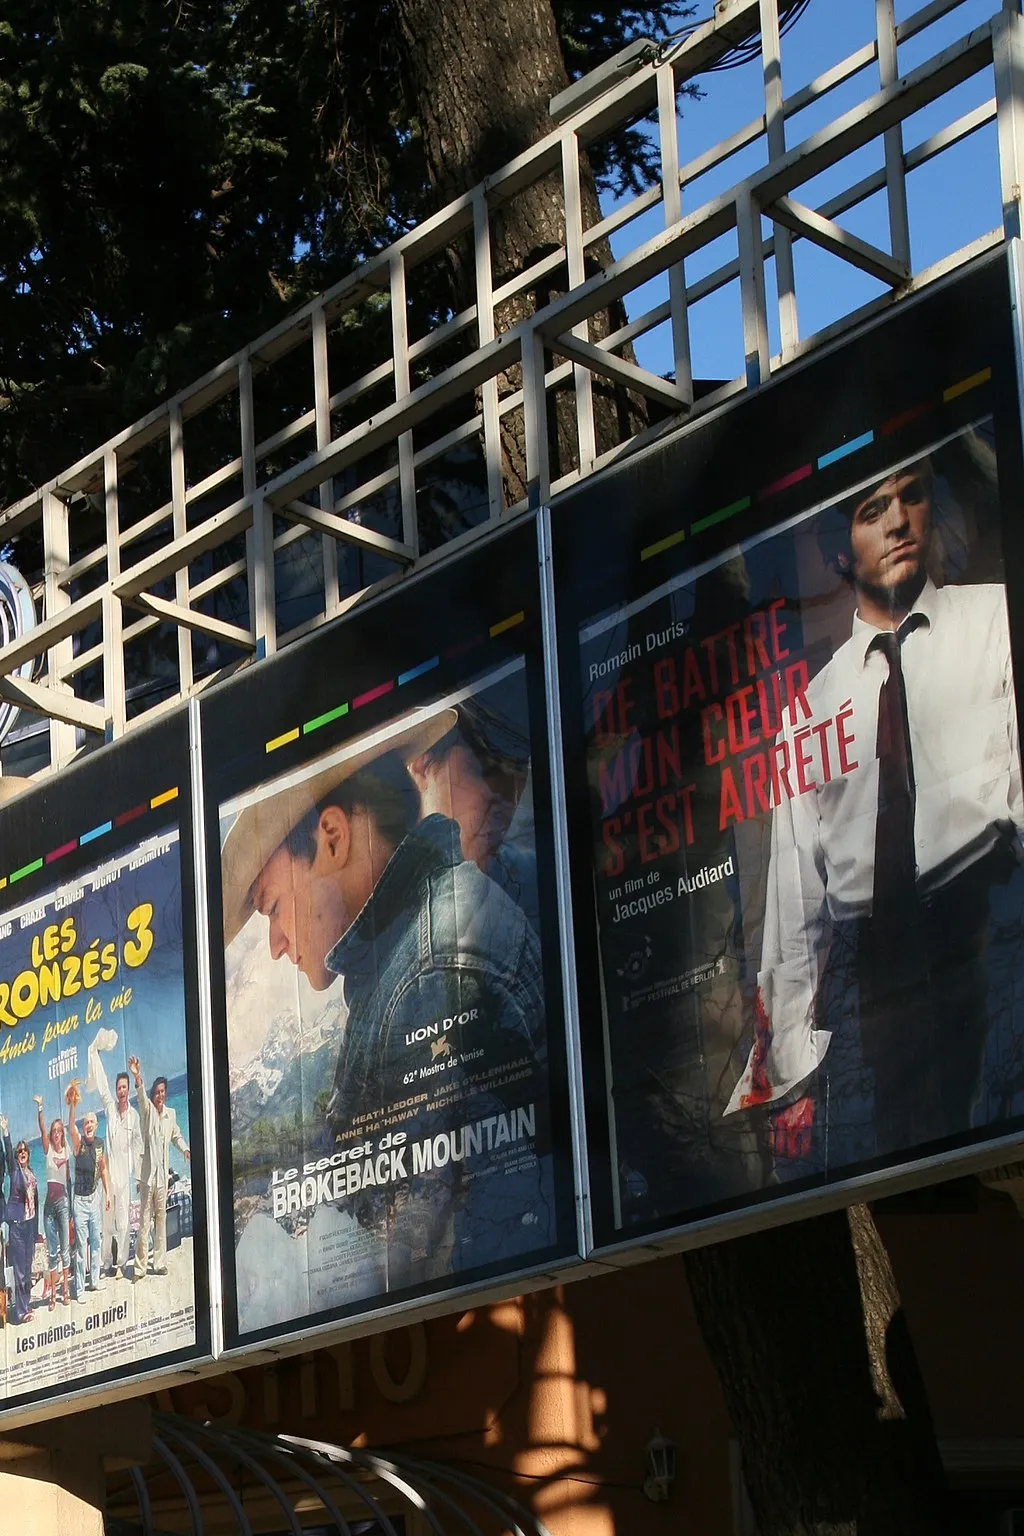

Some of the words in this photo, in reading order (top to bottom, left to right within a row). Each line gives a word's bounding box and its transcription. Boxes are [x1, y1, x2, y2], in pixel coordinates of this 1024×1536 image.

[589, 644, 641, 682] Romain
[646, 622, 685, 652] Duris
[593, 677, 638, 745] DE
[653, 599, 790, 719] BATTRE
[600, 725, 682, 810] MON
[702, 660, 813, 766] CŒUR
[602, 784, 697, 878] S'EST
[609, 888, 622, 901] un
[624, 878, 645, 893] film
[647, 870, 660, 885] de
[612, 886, 674, 923] Jacques
[677, 856, 734, 897] Audiard
[31, 917, 77, 968] LES
[123, 903, 154, 967] 3
[42, 1014, 79, 1053] pour
[85, 997, 103, 1024] la
[110, 986, 133, 1013] vie
[405, 1023, 439, 1046] LION
[442, 1008, 479, 1032] D'OR
[419, 1062, 446, 1079] Mostra
[447, 1056, 458, 1068] de
[461, 1048, 485, 1064] Venise
[335, 1126, 362, 1142] ANNE
[365, 1108, 420, 1132] HATHAWAY
[426, 1087, 477, 1112] MICHELLE
[480, 1069, 533, 1092] WILLIAMS
[387, 1093, 428, 1112] LEDGER
[433, 1081, 459, 1097] JAKE
[271, 1166, 299, 1185] Le
[302, 1140, 374, 1176] secret
[378, 1130, 407, 1151] de
[273, 1146, 407, 1219] BROKEBACK
[411, 1103, 536, 1175] MOUNTAIN
[16, 1335, 35, 1354] Les
[37, 1321, 83, 1348] mêmes...
[85, 1313, 100, 1331] en
[102, 1301, 127, 1328] pire!
